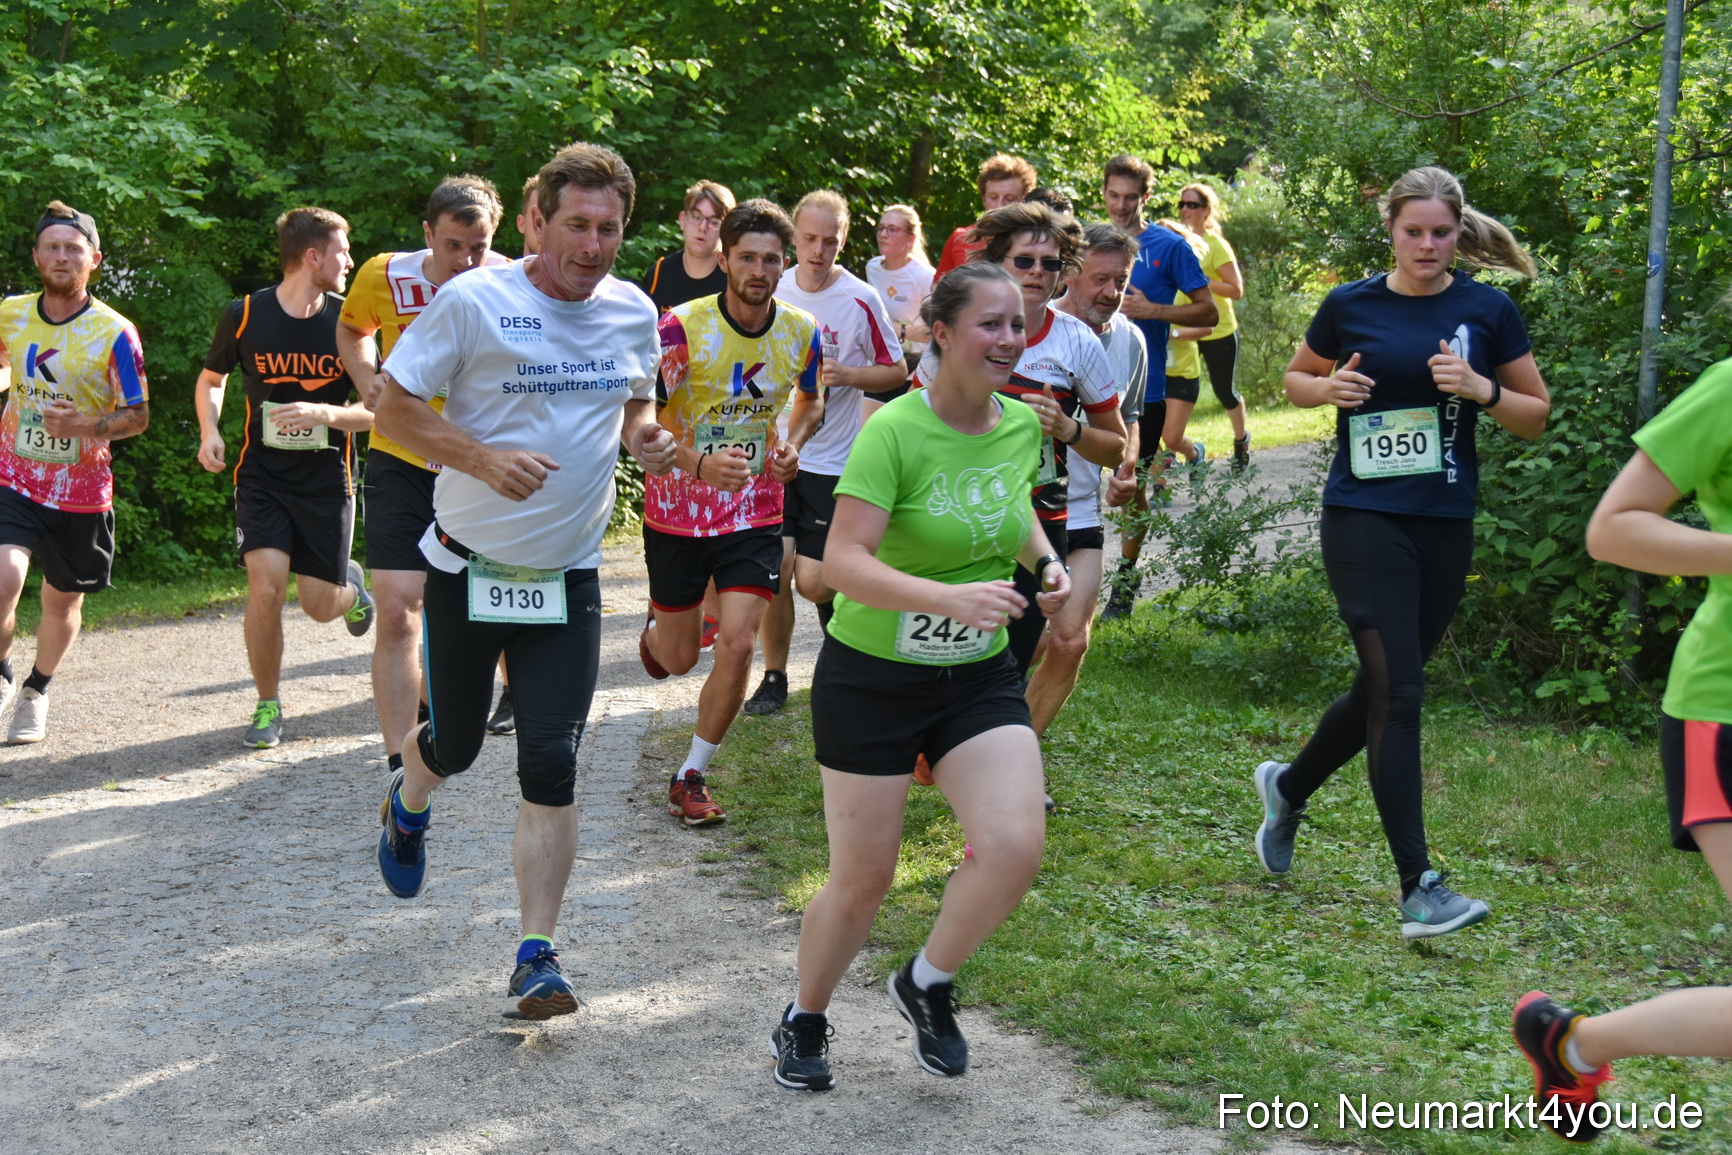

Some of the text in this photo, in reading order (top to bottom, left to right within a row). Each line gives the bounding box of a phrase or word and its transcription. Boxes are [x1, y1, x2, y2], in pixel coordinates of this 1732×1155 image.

[500, 316, 542, 330] DESS
[502, 329, 542, 337] Transporte
[502, 335, 542, 343] Logistik
[254, 352, 267, 374] BIT
[266, 352, 345, 378] WINGS
[517, 359, 616, 376] Unser Sport ist
[502, 376, 629, 395] SchüttguttranSport
[24, 427, 73, 452] 1319
[1361, 432, 1427, 459] 1950
[1375, 458, 1399, 466] Tresch
[489, 585, 545, 610] 9130
[919, 641, 977, 651] Haderer Nadine
